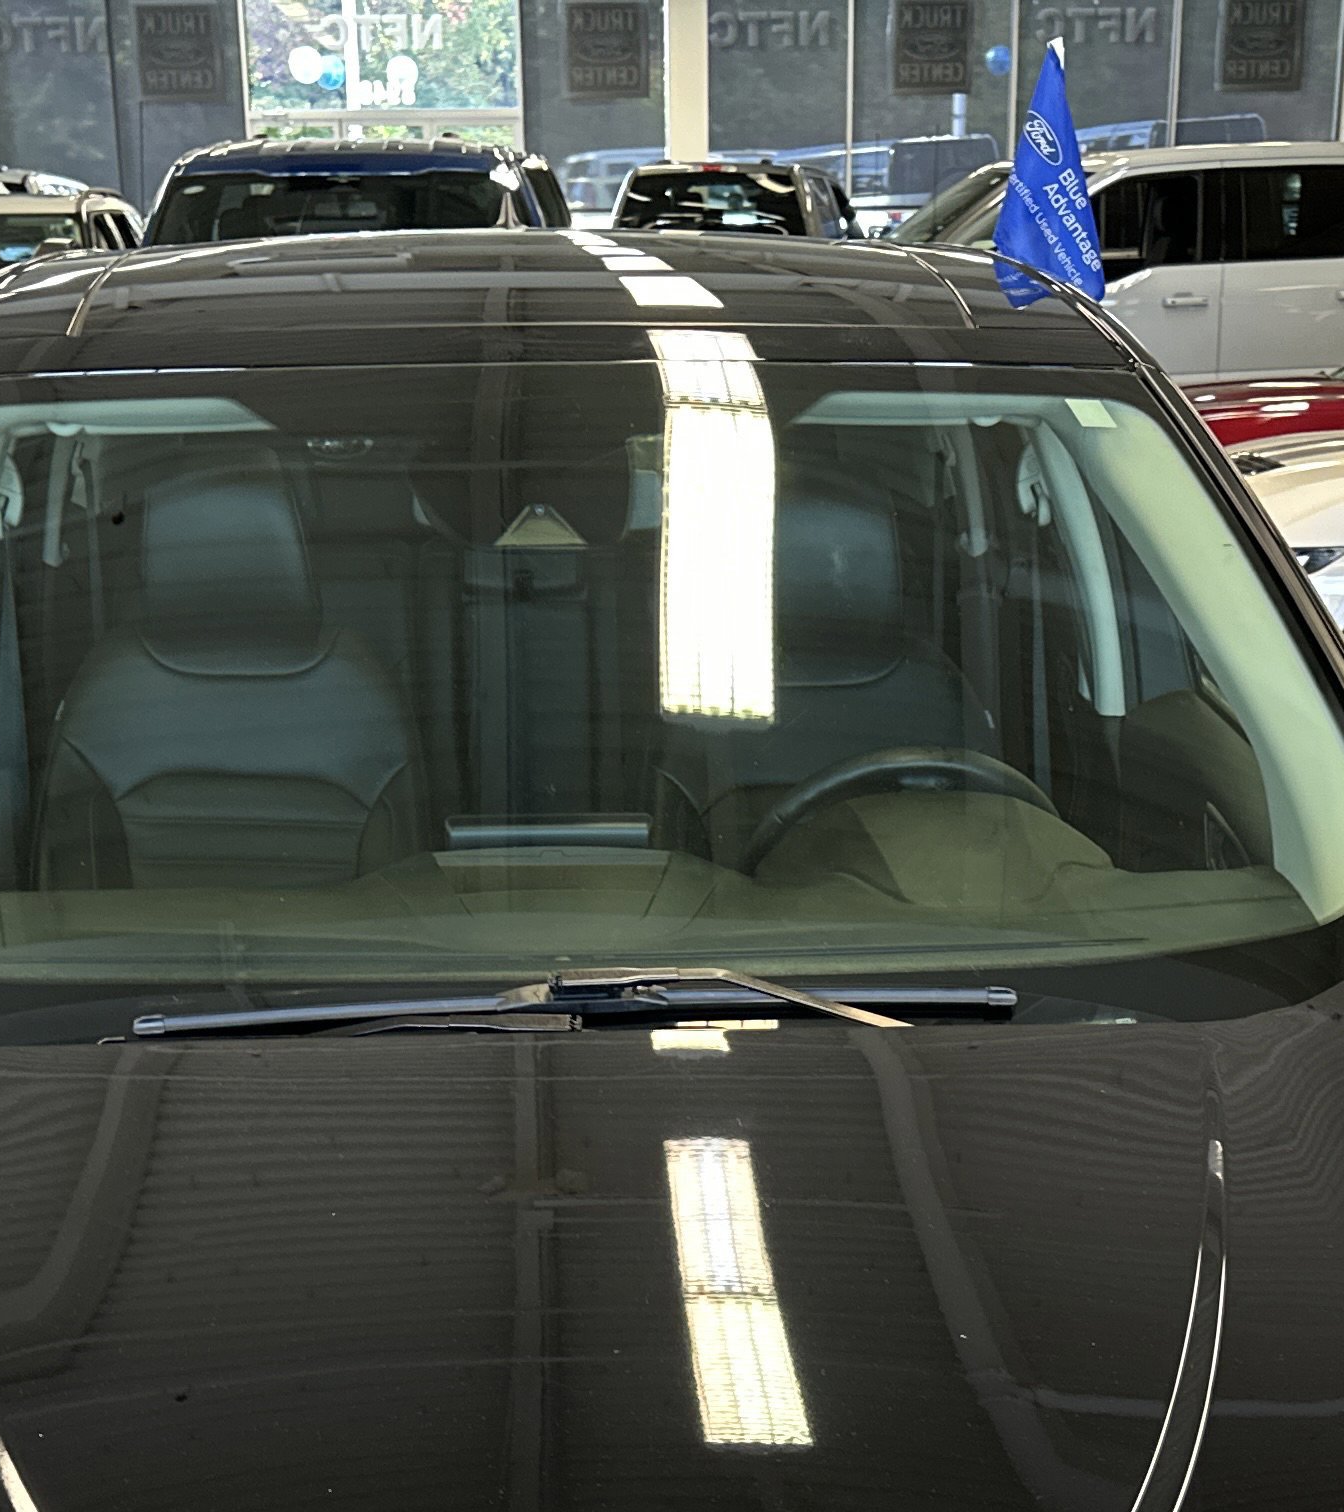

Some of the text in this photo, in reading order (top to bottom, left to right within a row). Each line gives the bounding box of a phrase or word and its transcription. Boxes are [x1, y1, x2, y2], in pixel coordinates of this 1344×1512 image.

[1025, 119, 1056, 156] Ford
[1058, 168, 1087, 210] Blue
[1008, 171, 1084, 289] ertified Used Vehicle
[1043, 183, 1102, 272] Advantage
